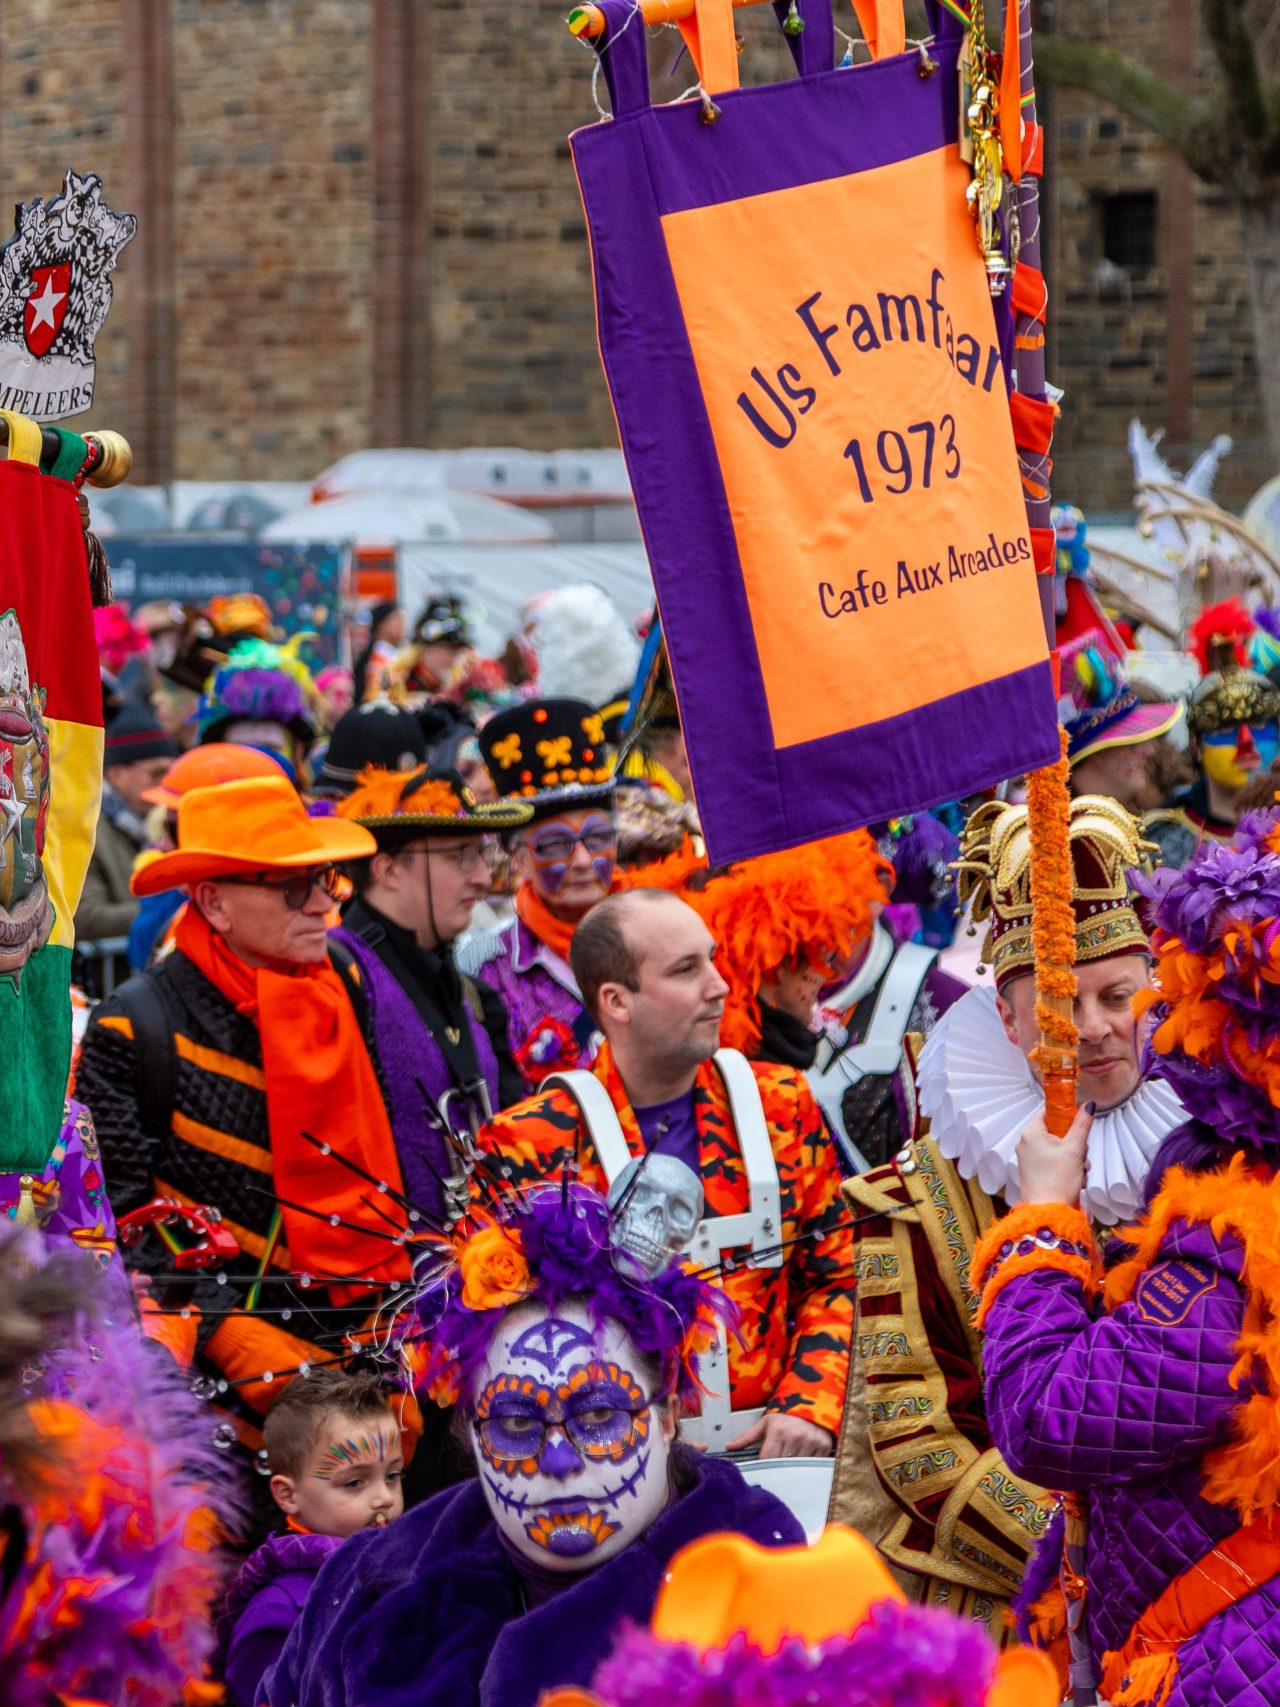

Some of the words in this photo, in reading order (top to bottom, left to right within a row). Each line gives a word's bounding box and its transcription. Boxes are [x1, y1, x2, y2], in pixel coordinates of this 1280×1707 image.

[736, 363, 816, 449] Us
[795, 268, 1002, 393] Famfaar
[843, 413, 961, 503] 1973
[818, 569, 887, 618] Cafe
[896, 561, 944, 599] Aux
[948, 533, 1031, 583] Arcades
